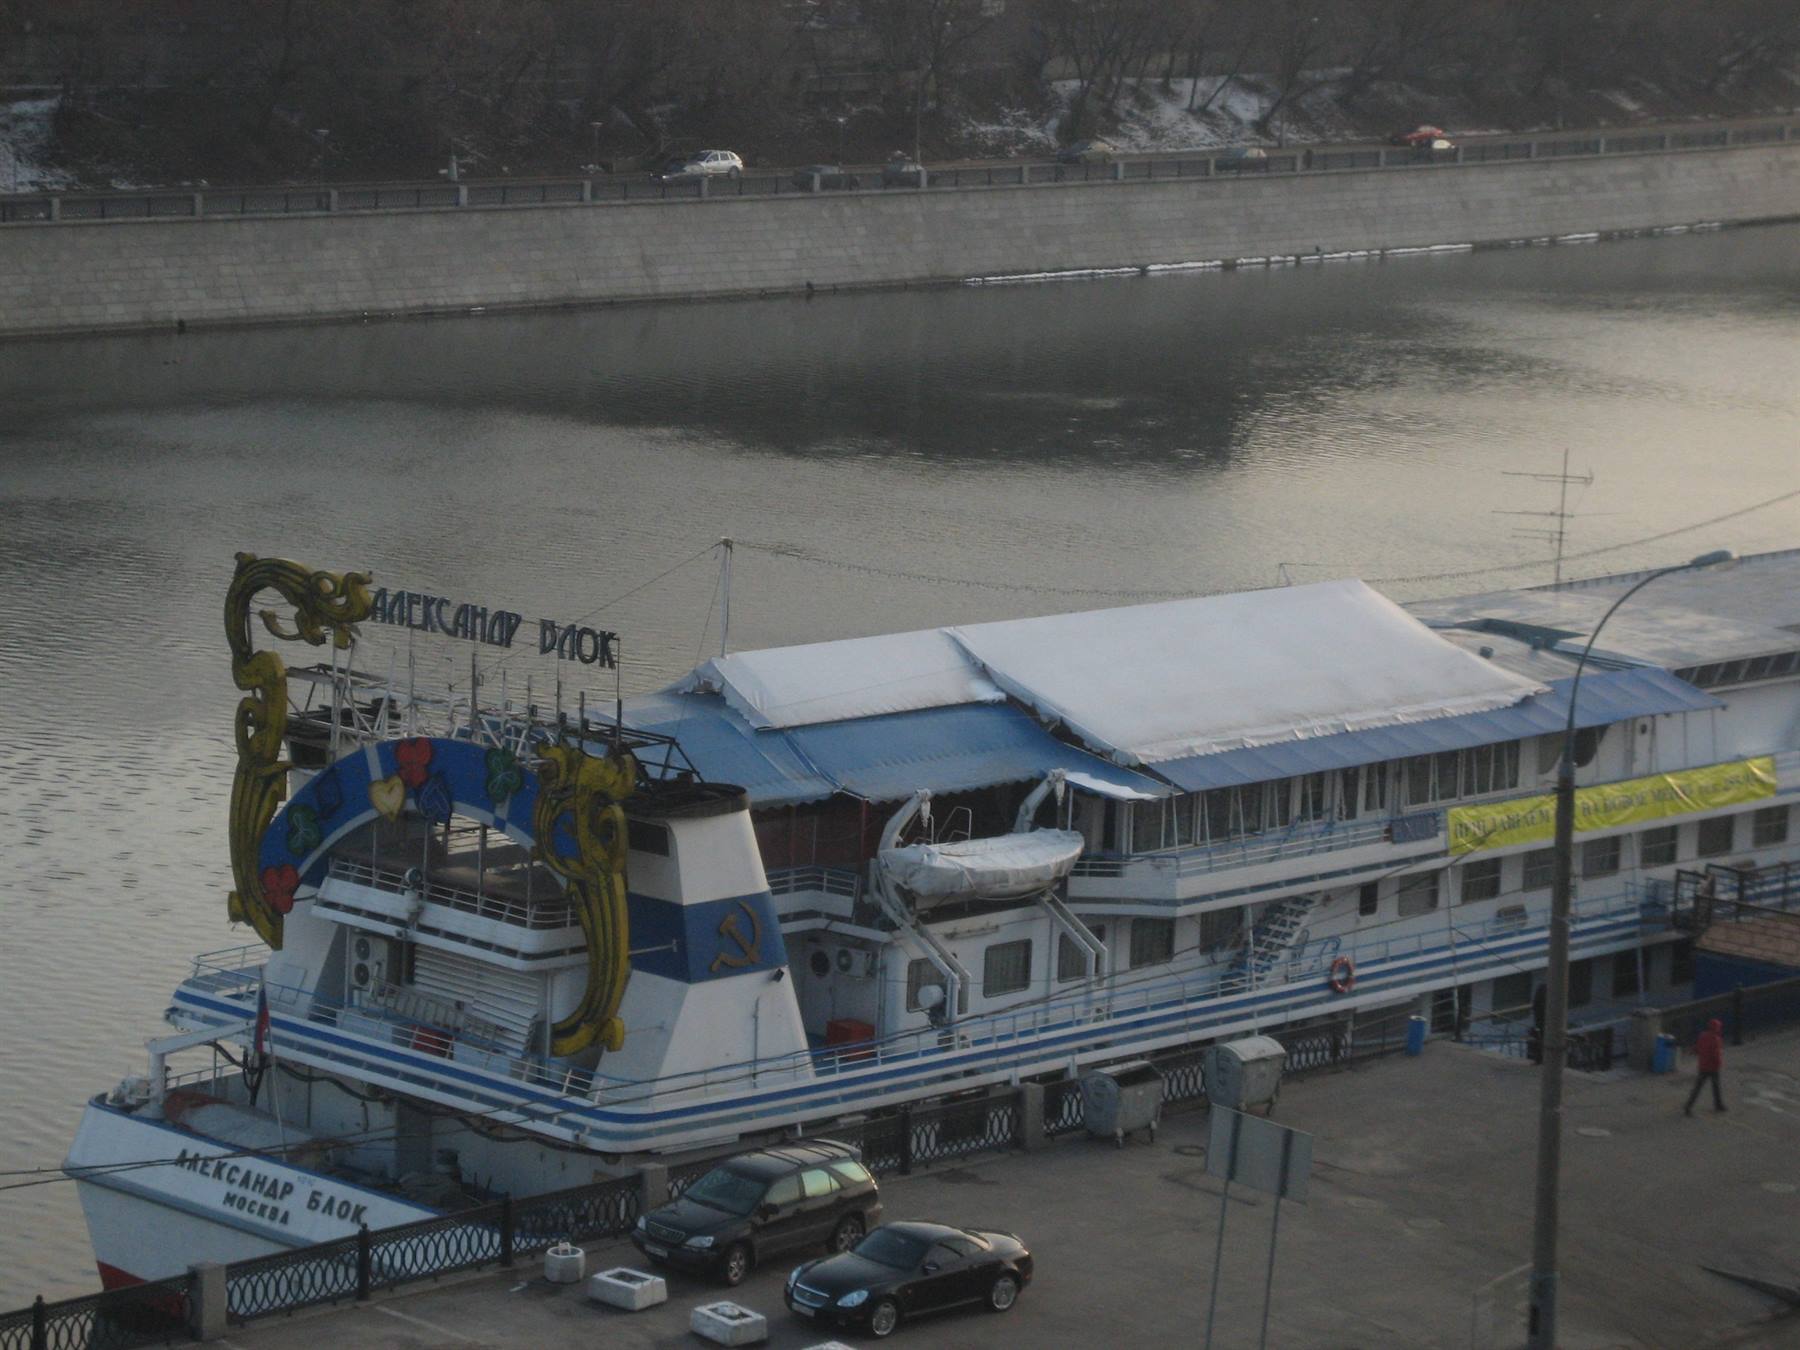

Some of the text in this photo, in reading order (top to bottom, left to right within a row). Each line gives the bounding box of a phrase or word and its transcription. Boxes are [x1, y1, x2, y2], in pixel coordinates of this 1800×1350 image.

[371, 587, 617, 670] АЛЕКСАНДР БЛОК
[175, 1148, 368, 1225] АЛЕКСАНДР БЛОК
[222, 1192, 290, 1226] МОСКВА
